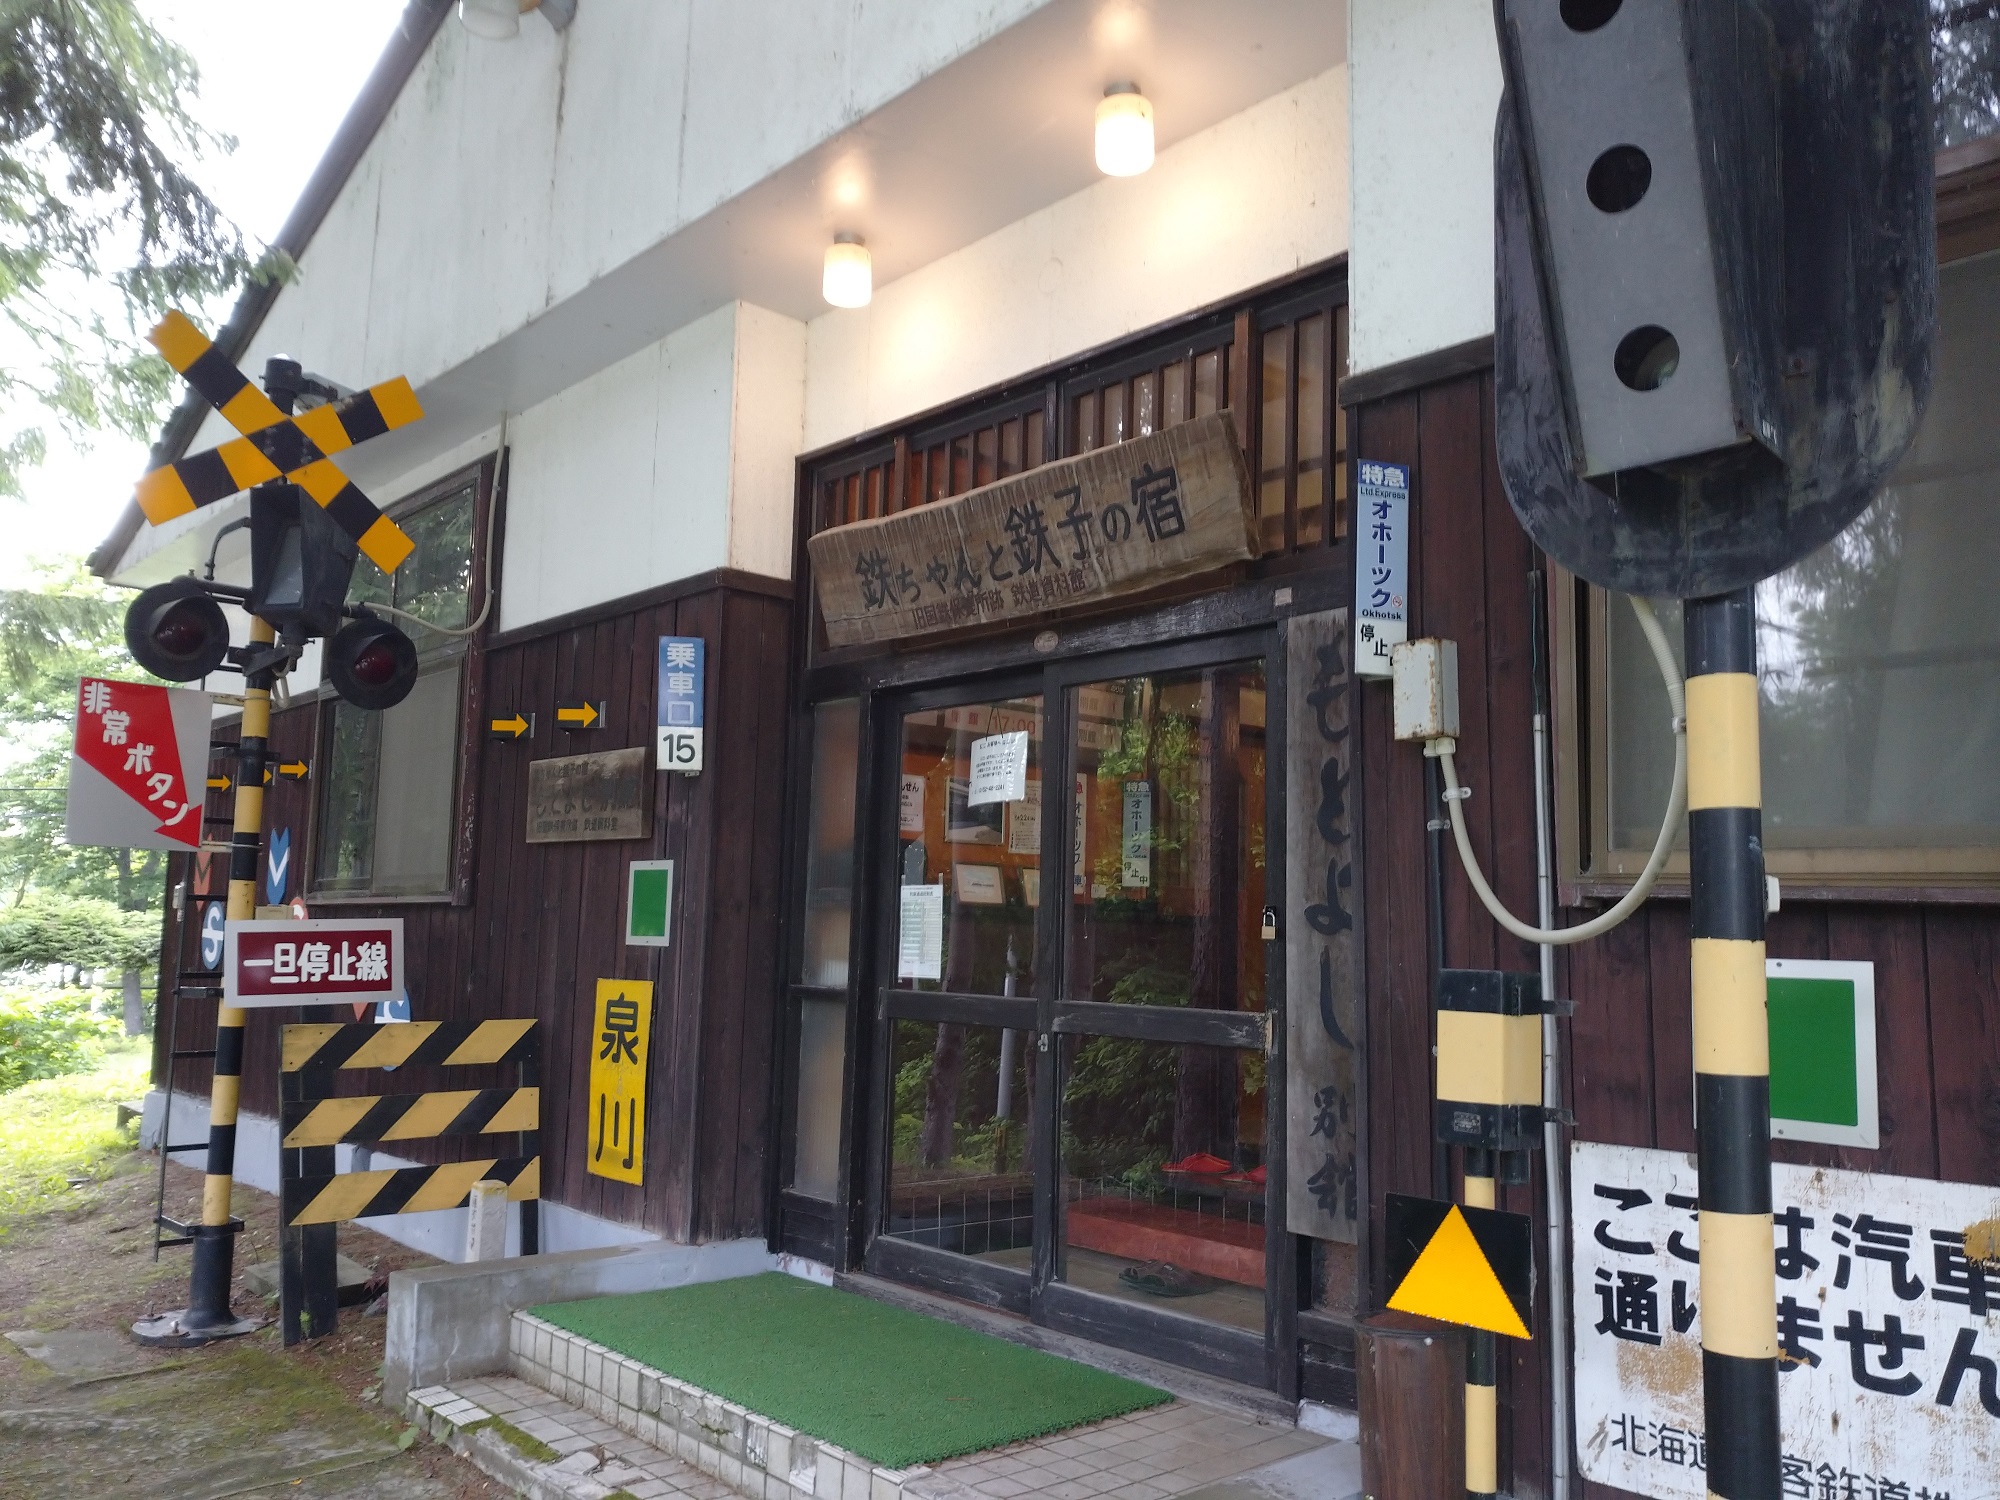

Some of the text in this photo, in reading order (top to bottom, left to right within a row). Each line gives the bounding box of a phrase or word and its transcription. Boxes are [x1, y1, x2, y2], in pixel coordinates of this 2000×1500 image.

[1361, 463, 1405, 487] 特急
[855, 462, 1186, 611] 鉄ちゃんと鉄子の宿
[1371, 500, 1393, 608] オホーツク
[1360, 624, 1394, 667] 停止
[1361, 609, 1402, 620] Okhotsk
[666, 643, 695, 725] 乗車口
[83, 681, 189, 827] 非常ボタン
[662, 733, 696, 763] 15
[243, 940, 389, 985] 一旦停止線
[595, 992, 639, 1170] 泉川
